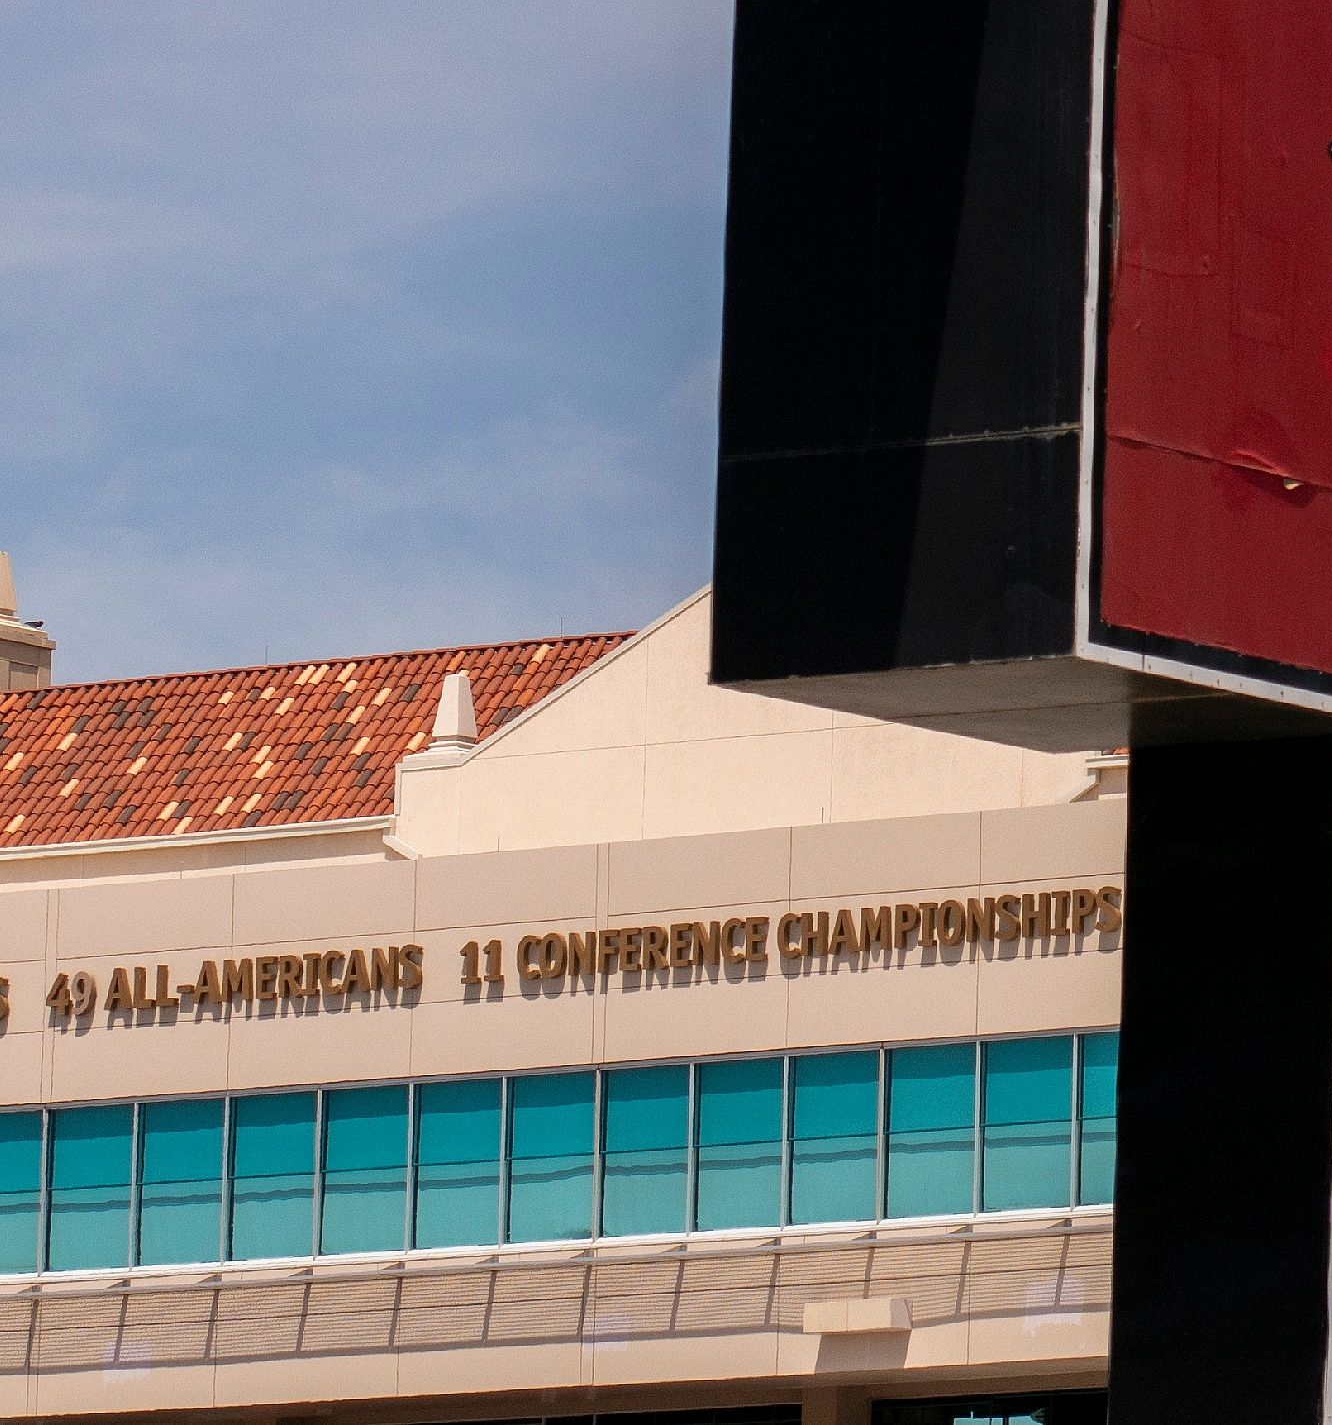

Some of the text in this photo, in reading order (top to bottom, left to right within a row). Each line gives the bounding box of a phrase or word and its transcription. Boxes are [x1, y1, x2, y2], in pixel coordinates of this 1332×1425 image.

[46, 971, 97, 1016] 49
[104, 943, 424, 1011] ALL-AMERICANS
[460, 940, 504, 984] 11
[517, 916, 769, 980] CONFERENCE
[777, 886, 1122, 960] CHAMPIONSHIPS
